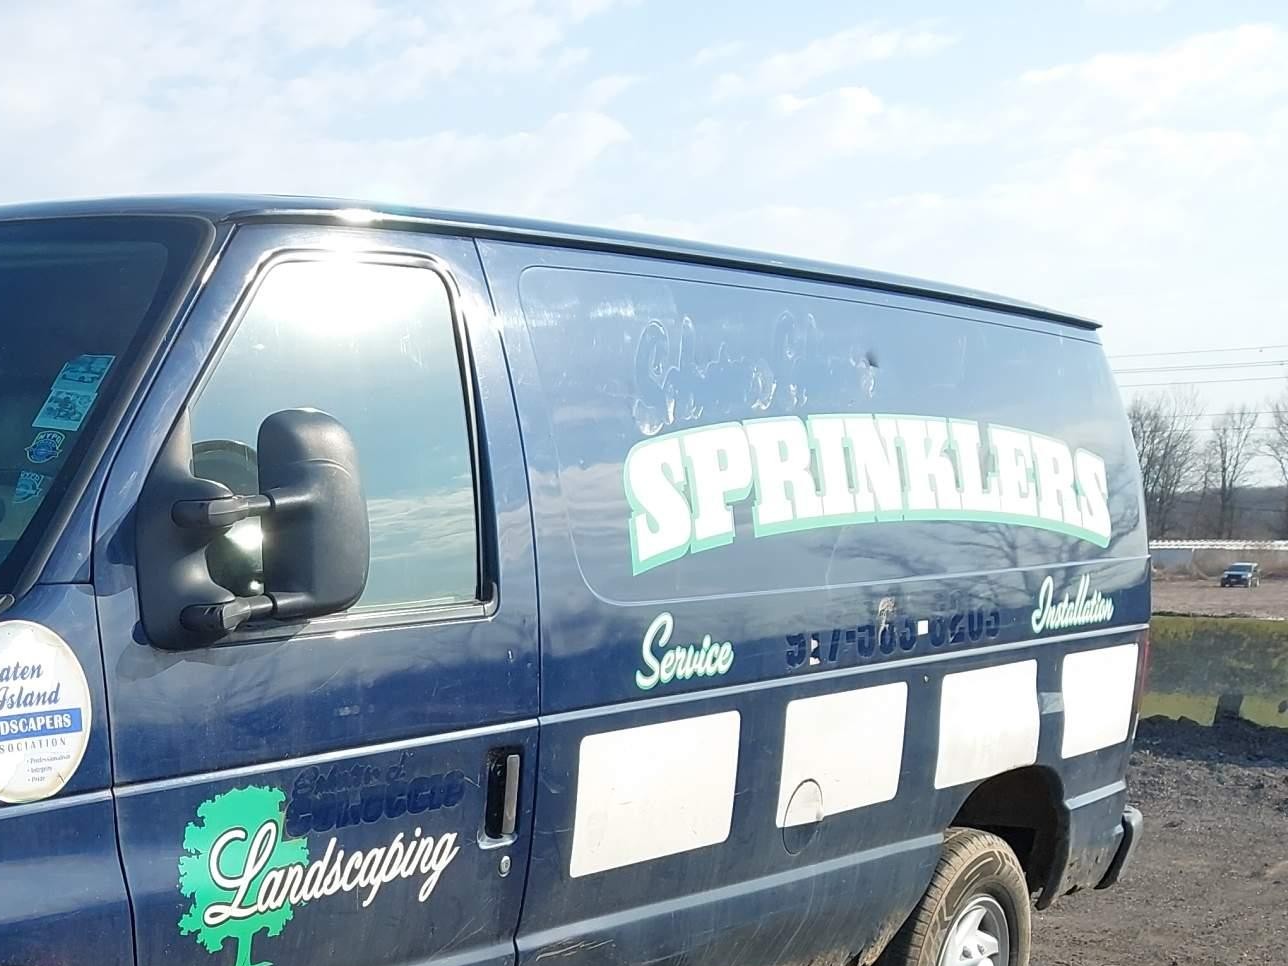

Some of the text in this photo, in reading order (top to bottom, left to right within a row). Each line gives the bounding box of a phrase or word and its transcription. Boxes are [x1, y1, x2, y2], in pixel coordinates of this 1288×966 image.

[624, 413, 1111, 574] SPRINKLERS
[1031, 572, 1114, 634] Installation
[634, 610, 735, 691] Service
[203, 820, 460, 926] Landscaping
